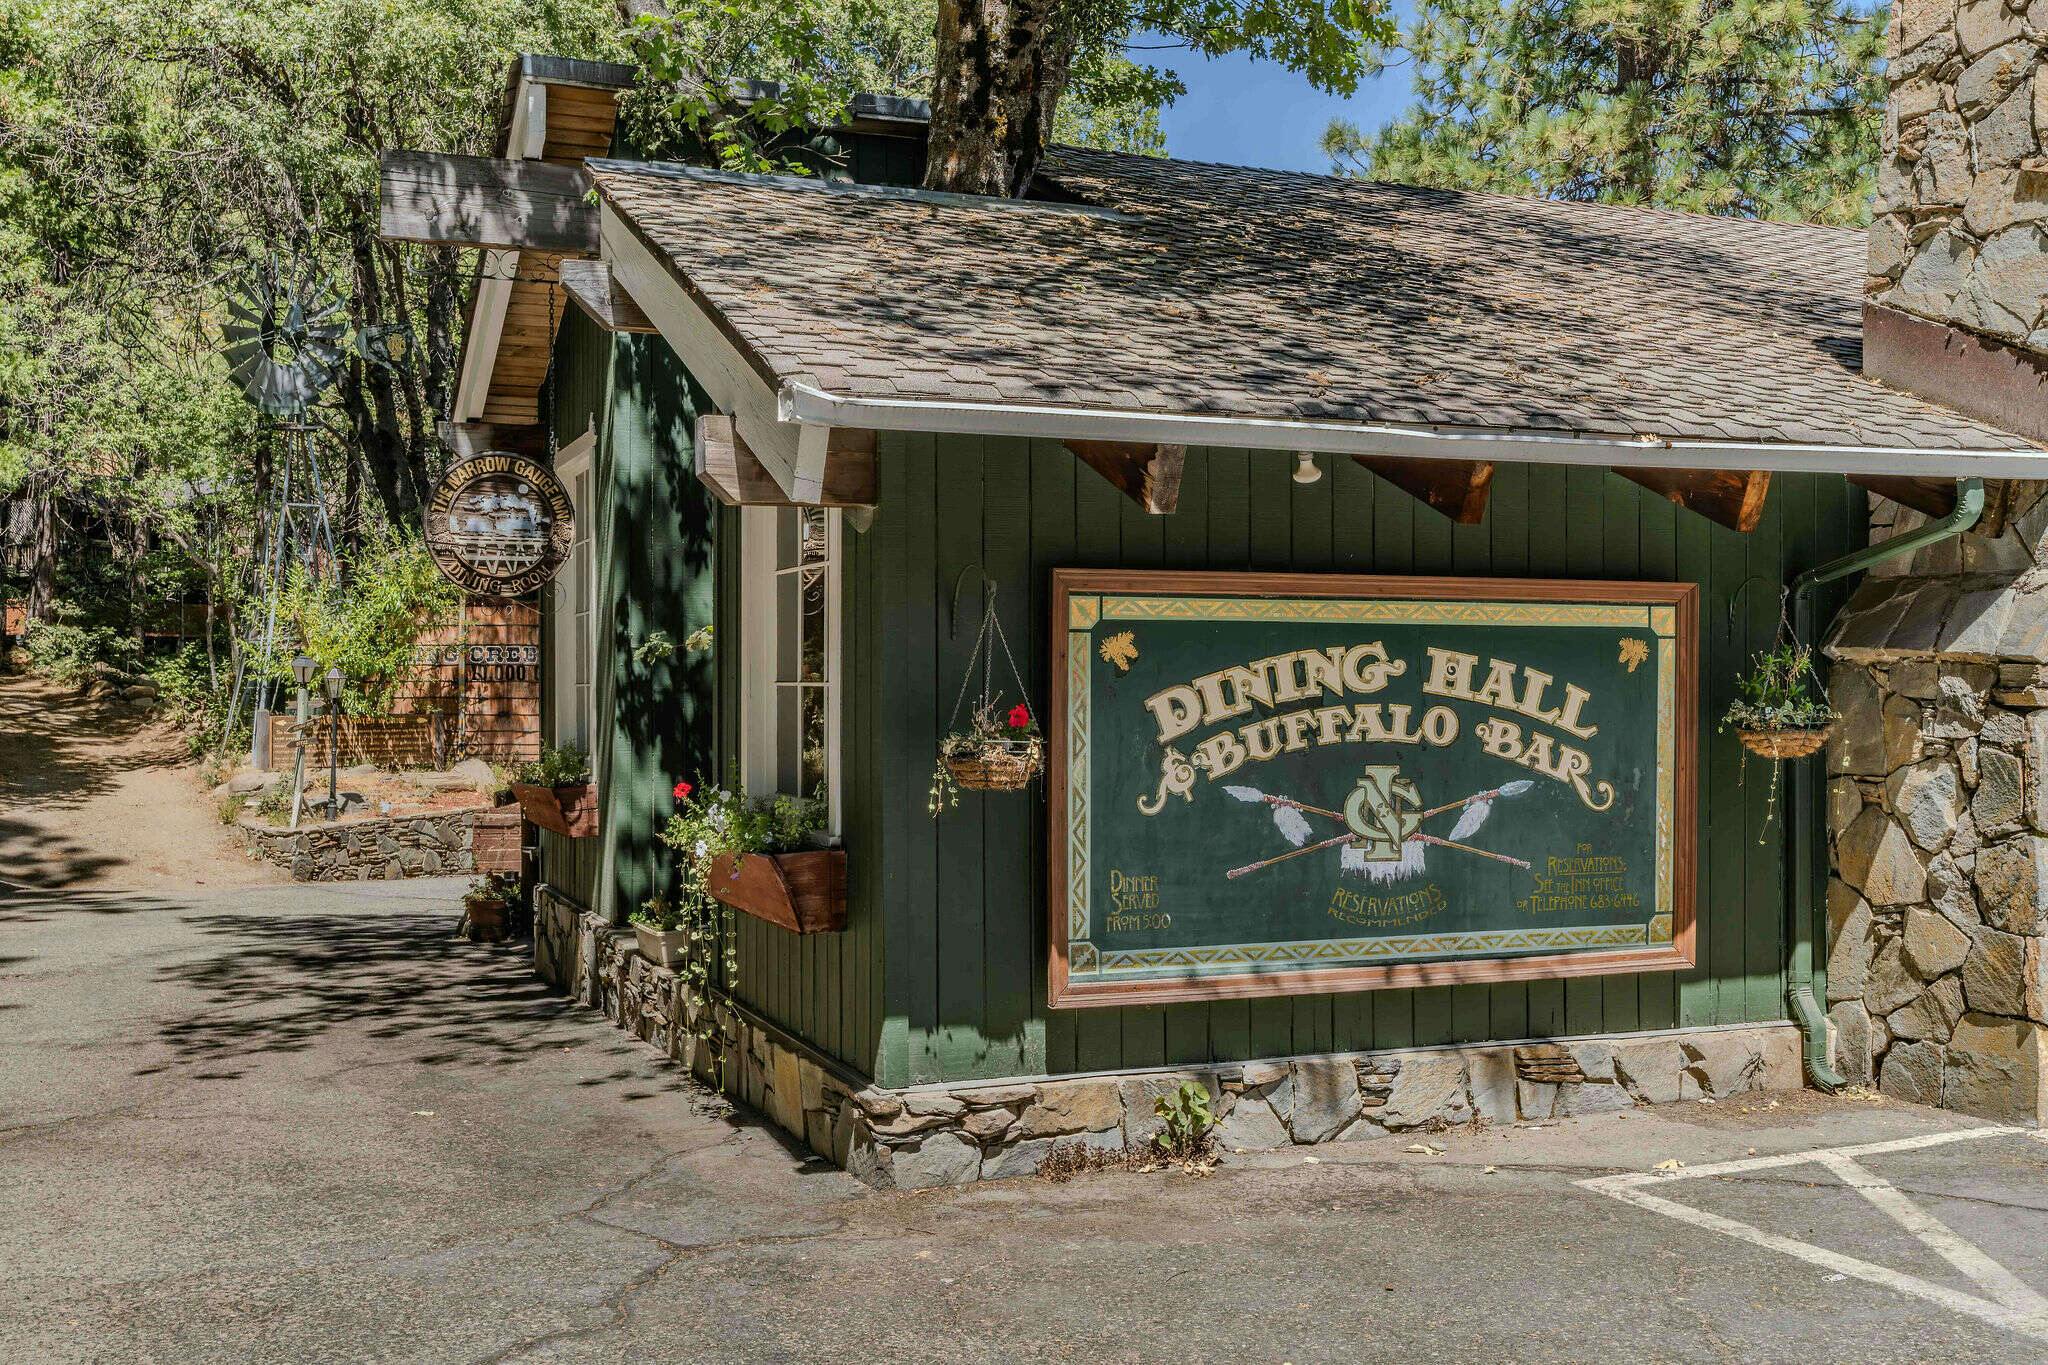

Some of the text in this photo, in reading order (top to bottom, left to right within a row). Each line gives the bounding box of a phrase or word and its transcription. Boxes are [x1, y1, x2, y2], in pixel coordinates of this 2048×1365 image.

[431, 457, 571, 521] THE NARROW GAUGE INN
[448, 561, 551, 595] DINING ROOM
[1144, 641, 1599, 745] DINING HALL
[1137, 704, 1616, 816] & BUFFALO BAR
[1332, 884, 1441, 916] RESERVATIONS
